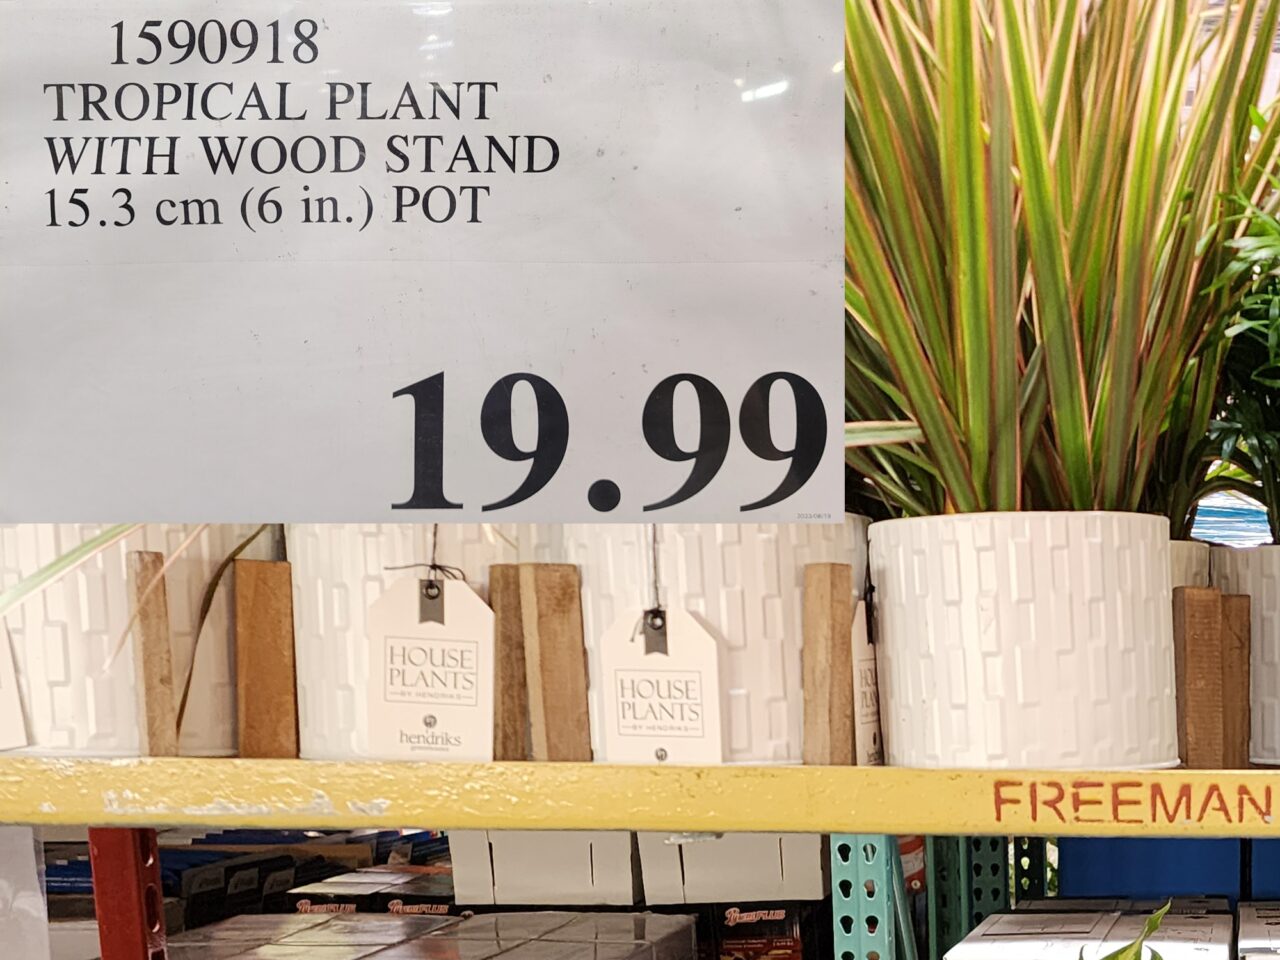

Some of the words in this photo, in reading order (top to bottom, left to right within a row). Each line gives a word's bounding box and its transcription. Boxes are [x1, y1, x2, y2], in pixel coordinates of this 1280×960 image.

[110, 19, 320, 66] 1590918
[43, 82, 307, 123] TROPICAL
[326, 81, 498, 121] PLANT
[44, 136, 178, 176] WITH
[201, 135, 367, 175] WOOD
[385, 134, 560, 174] STAND
[44, 187, 136, 228] 15.3
[155, 196, 222, 226] cm
[240, 186, 283, 231] (6
[301, 185, 374, 231] in.)
[391, 186, 491, 224] POT
[391, 371, 828, 514] 19.99
[389, 645, 474, 671] HOUSE
[389, 667, 477, 691] PLANTS
[619, 678, 698, 701] HOUSE
[620, 701, 702, 722] PLANTS
[399, 729, 462, 747] hendriks
[993, 780, 1273, 825] FREEMAN
